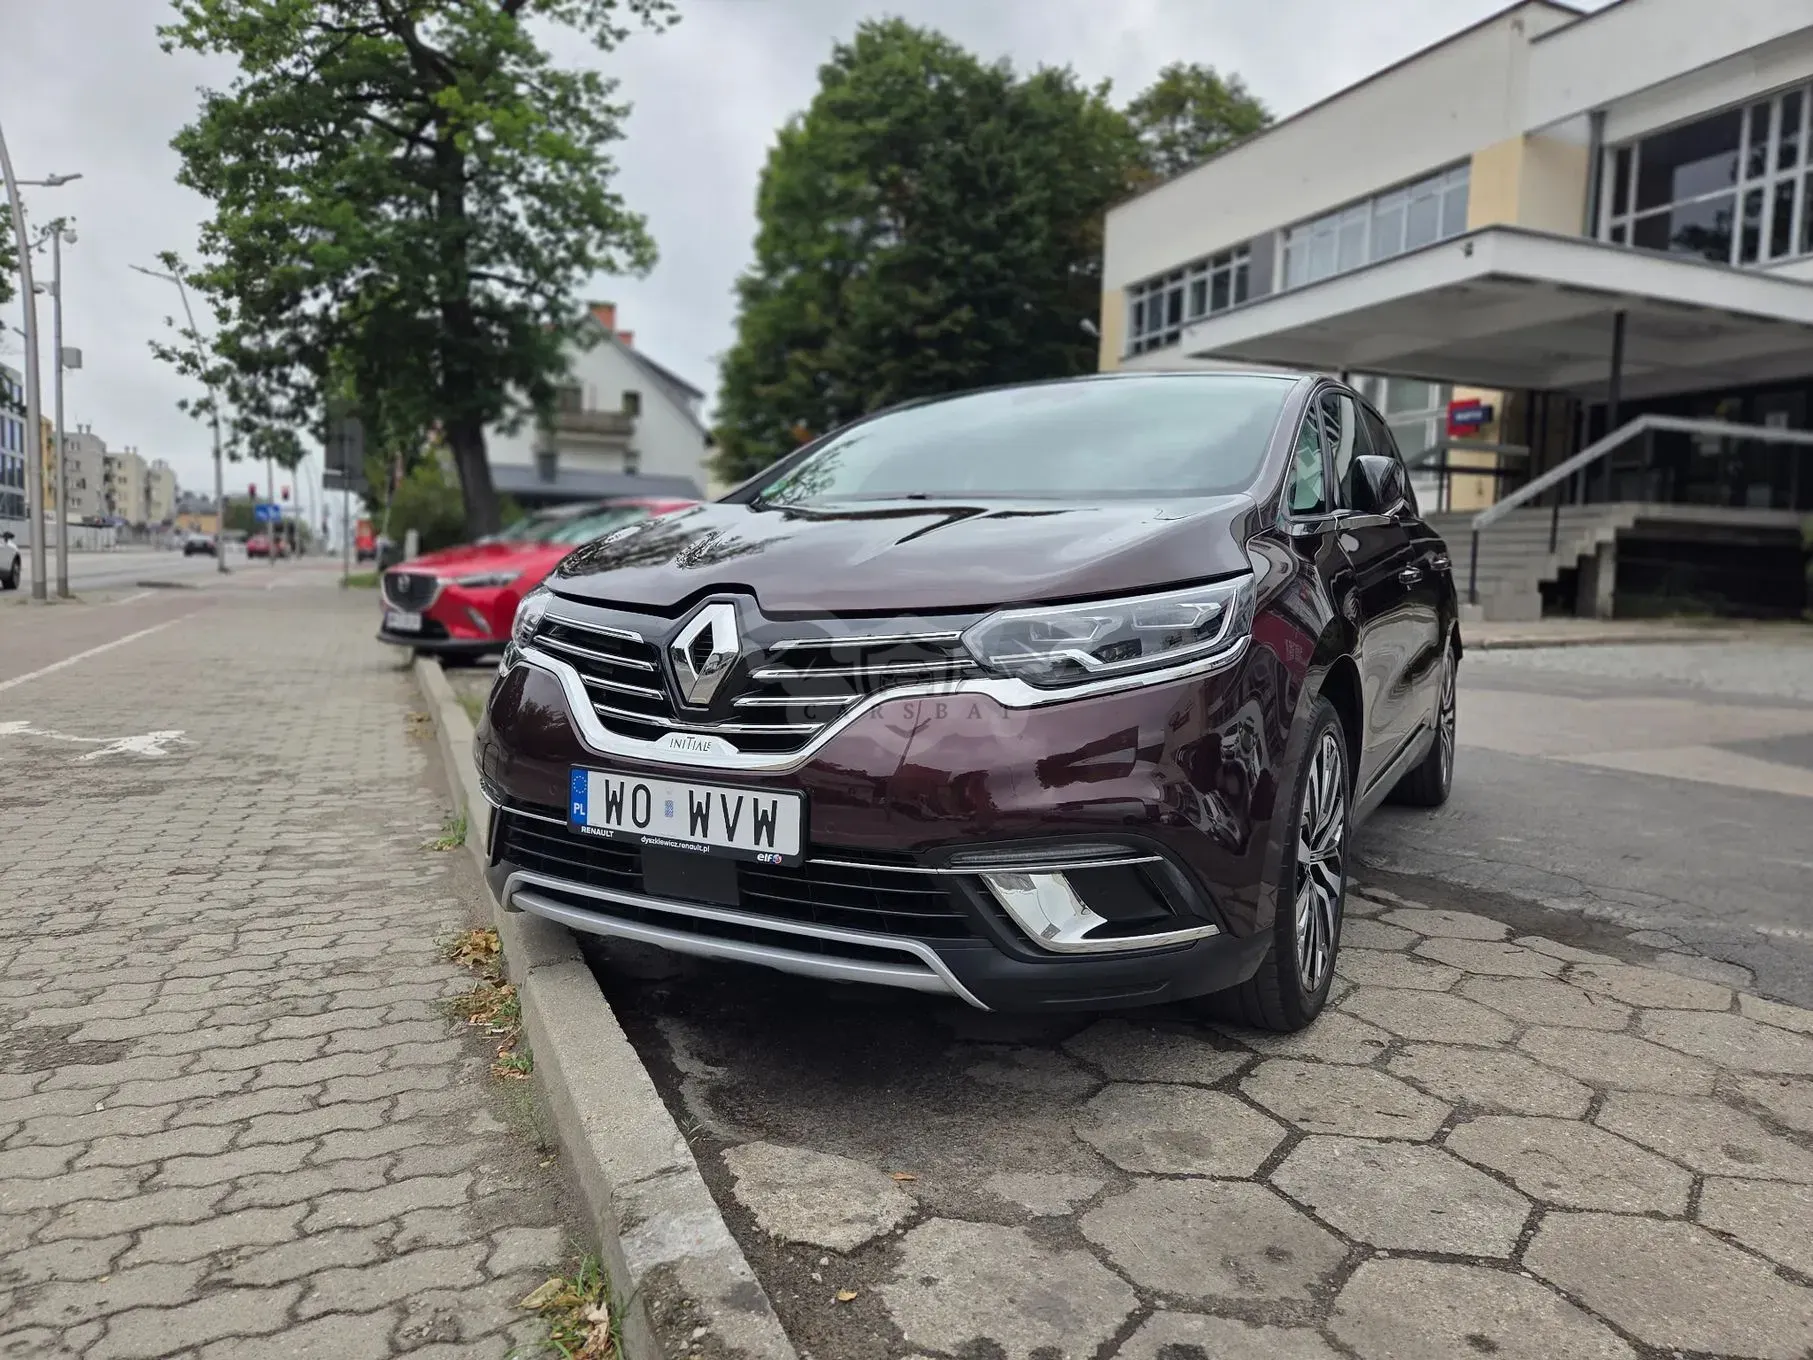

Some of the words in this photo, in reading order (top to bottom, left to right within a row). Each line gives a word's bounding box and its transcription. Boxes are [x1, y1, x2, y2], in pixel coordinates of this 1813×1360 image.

[669, 736, 713, 752] INITIALE
[573, 802, 586, 816] PL
[604, 779, 651, 828] WO
[688, 789, 778, 848] WVW
[581, 825, 614, 838] RENAULT
[757, 852, 774, 863] elf
